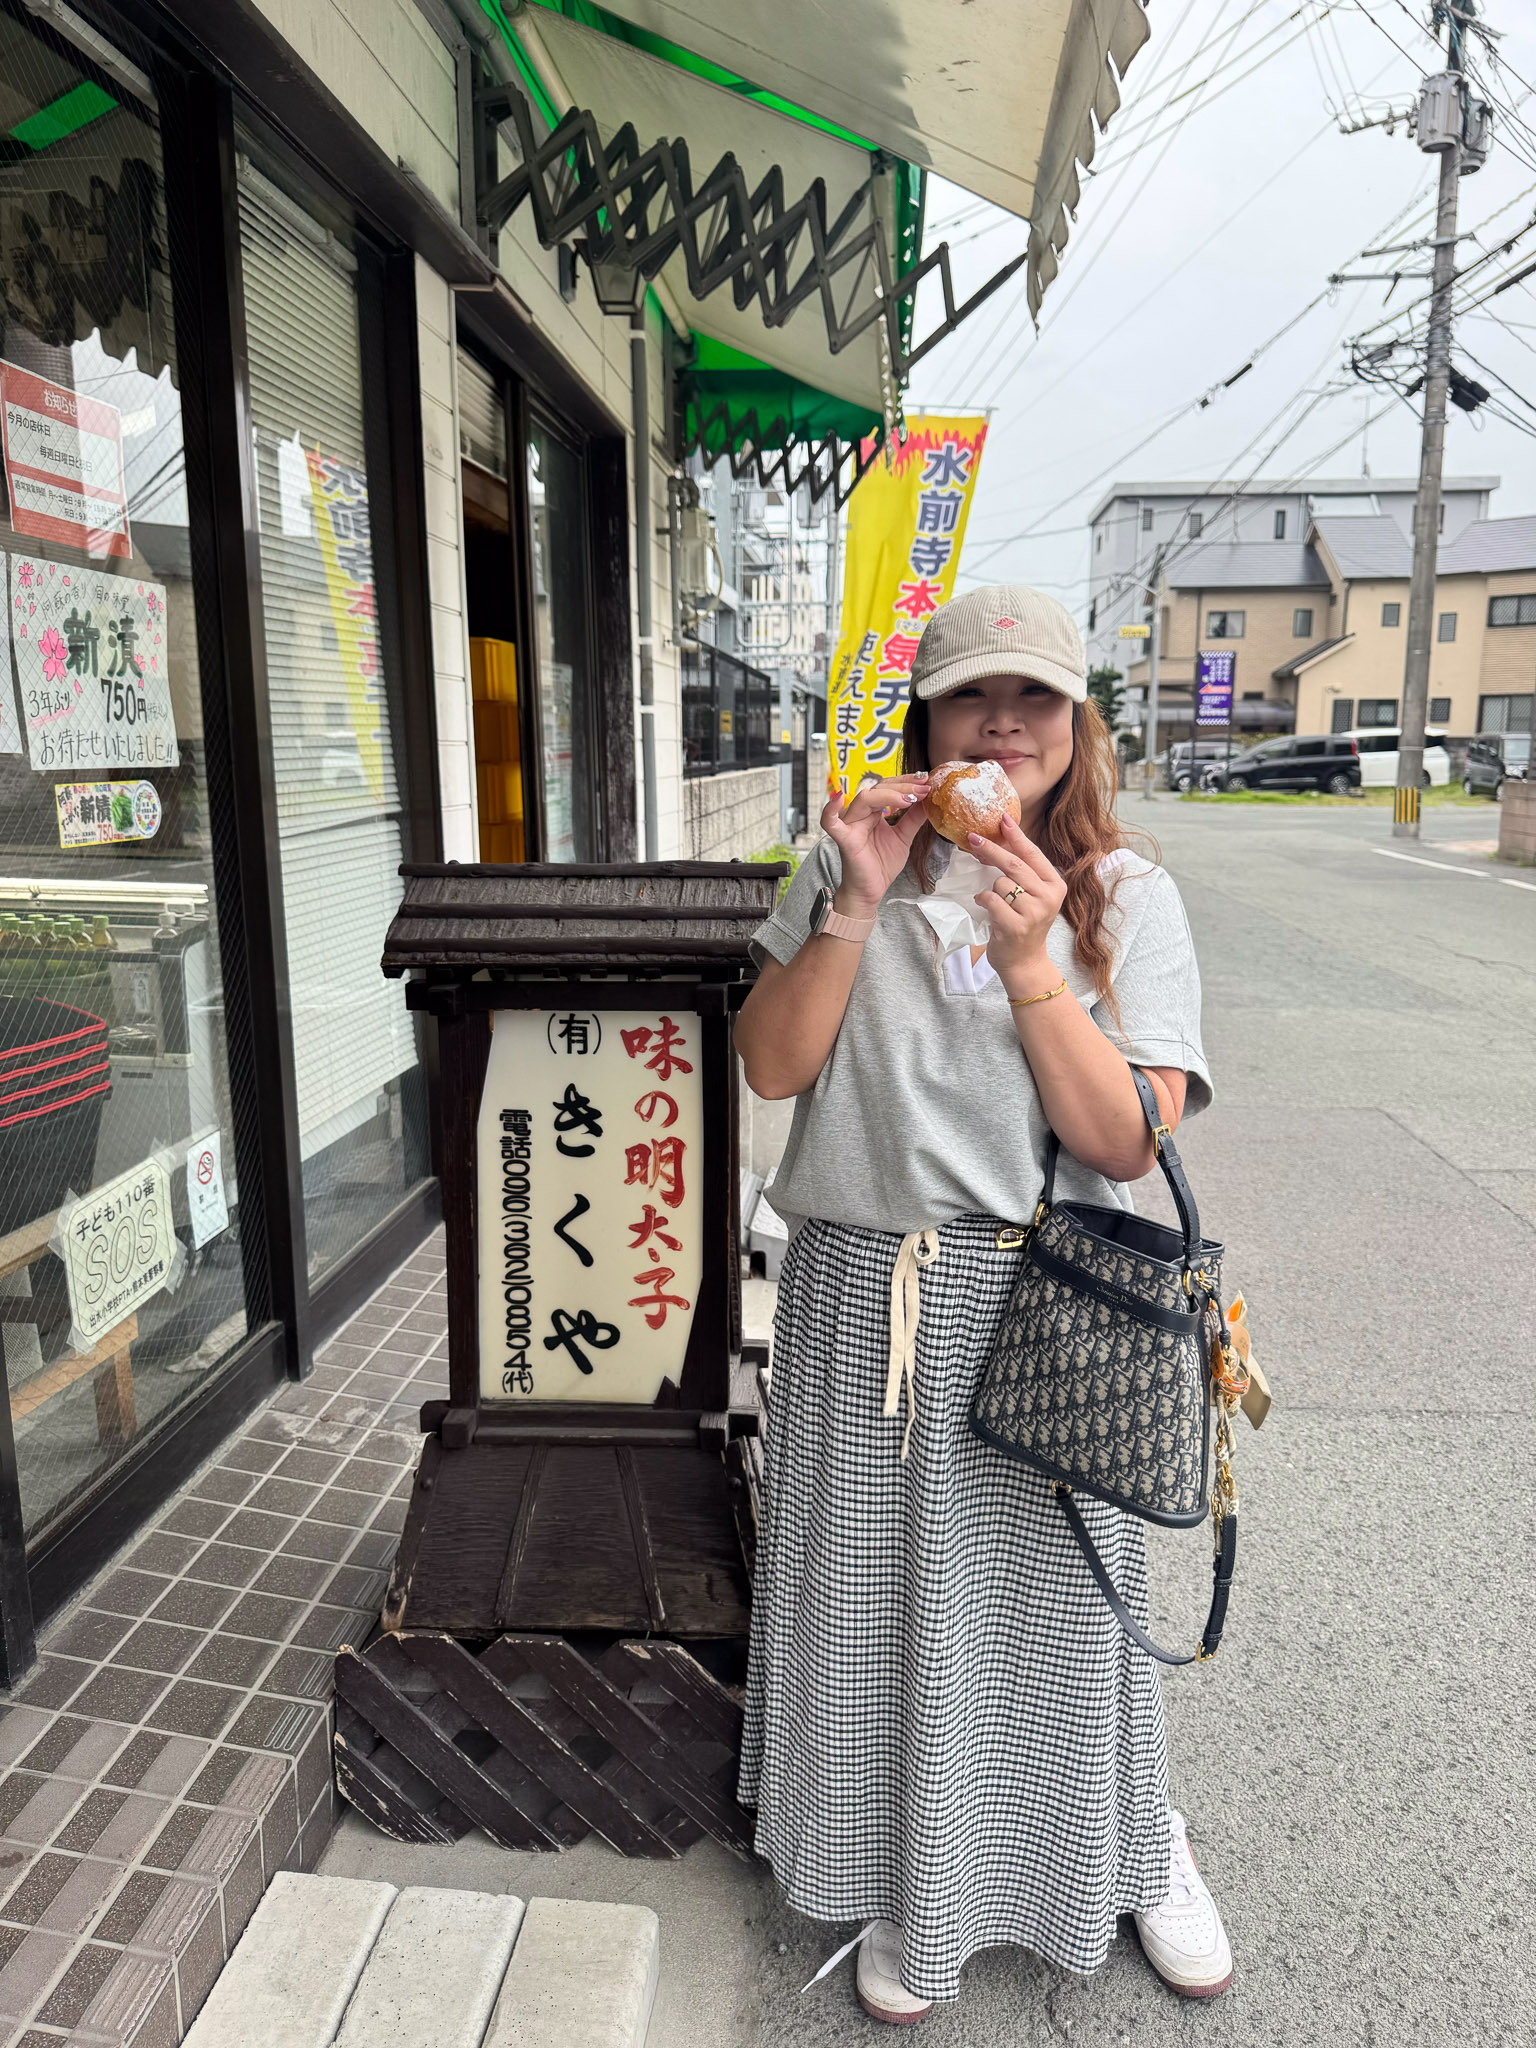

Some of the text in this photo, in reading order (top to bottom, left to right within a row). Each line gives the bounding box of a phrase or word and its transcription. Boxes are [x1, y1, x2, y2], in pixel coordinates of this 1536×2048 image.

[43, 388, 79, 418] お知らせ
[7, 411, 51, 437] 今月の店休日
[39, 445, 93, 473] 毎週日曜日と祝日
[63, 607, 144, 679] 新漬
[28, 690, 72, 718] 3年ぶり
[79, 793, 112, 825] 新漬
[619, 1015, 694, 1331] 味の明太子
[75, 1173, 156, 1242] 子ども110番
[84, 1198, 159, 1305] SOS
